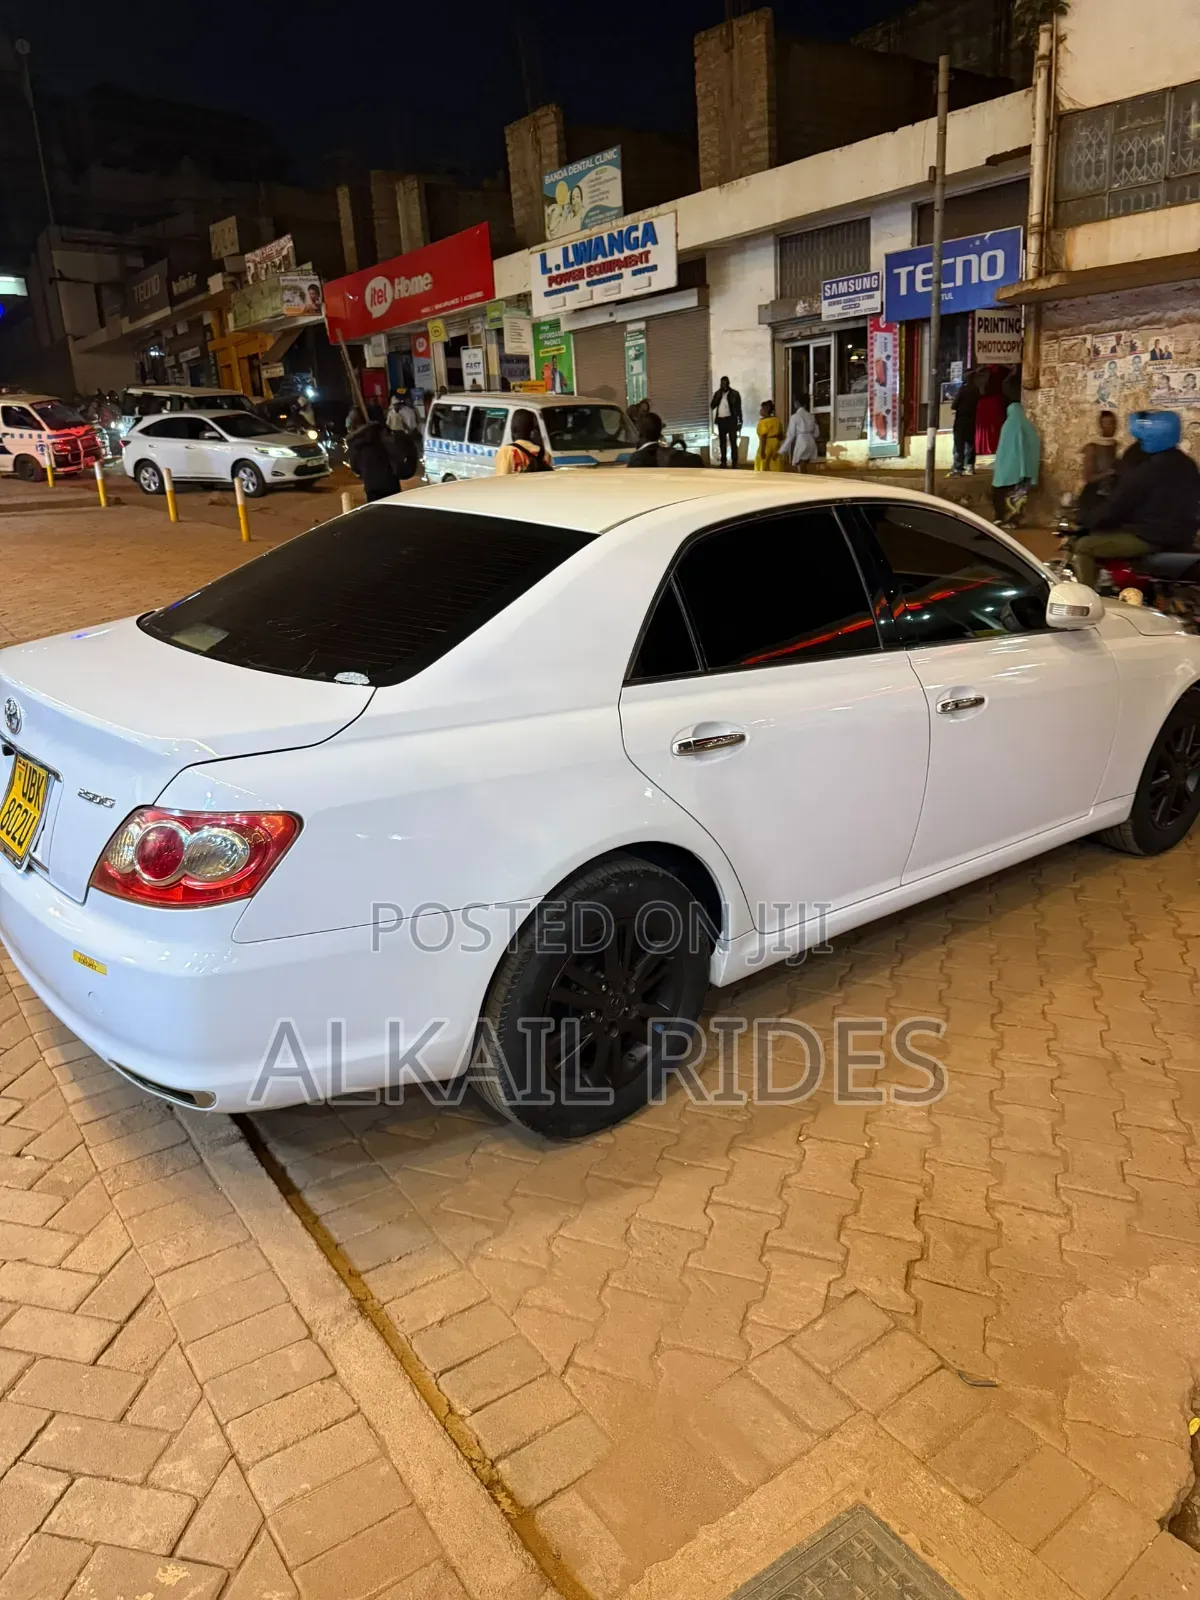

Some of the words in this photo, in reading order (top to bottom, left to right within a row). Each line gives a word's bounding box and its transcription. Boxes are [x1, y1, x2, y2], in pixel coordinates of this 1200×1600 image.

[544, 170, 568, 184] BANDA
[568, 160, 594, 175] DENTAL
[595, 149, 618, 165] CLINIC
[548, 268, 585, 288] POWER
[585, 250, 651, 278] EQUIPMENT
[824, 275, 879, 297] SAMSUNG
[893, 248, 1005, 296] TECNO
[370, 281, 388, 309] itel
[394, 272, 433, 300] Home
[977, 316, 1021, 334] PRINTING
[977, 340, 1022, 353] PHOTOCOPY
[22, 761, 45, 811] UBK
